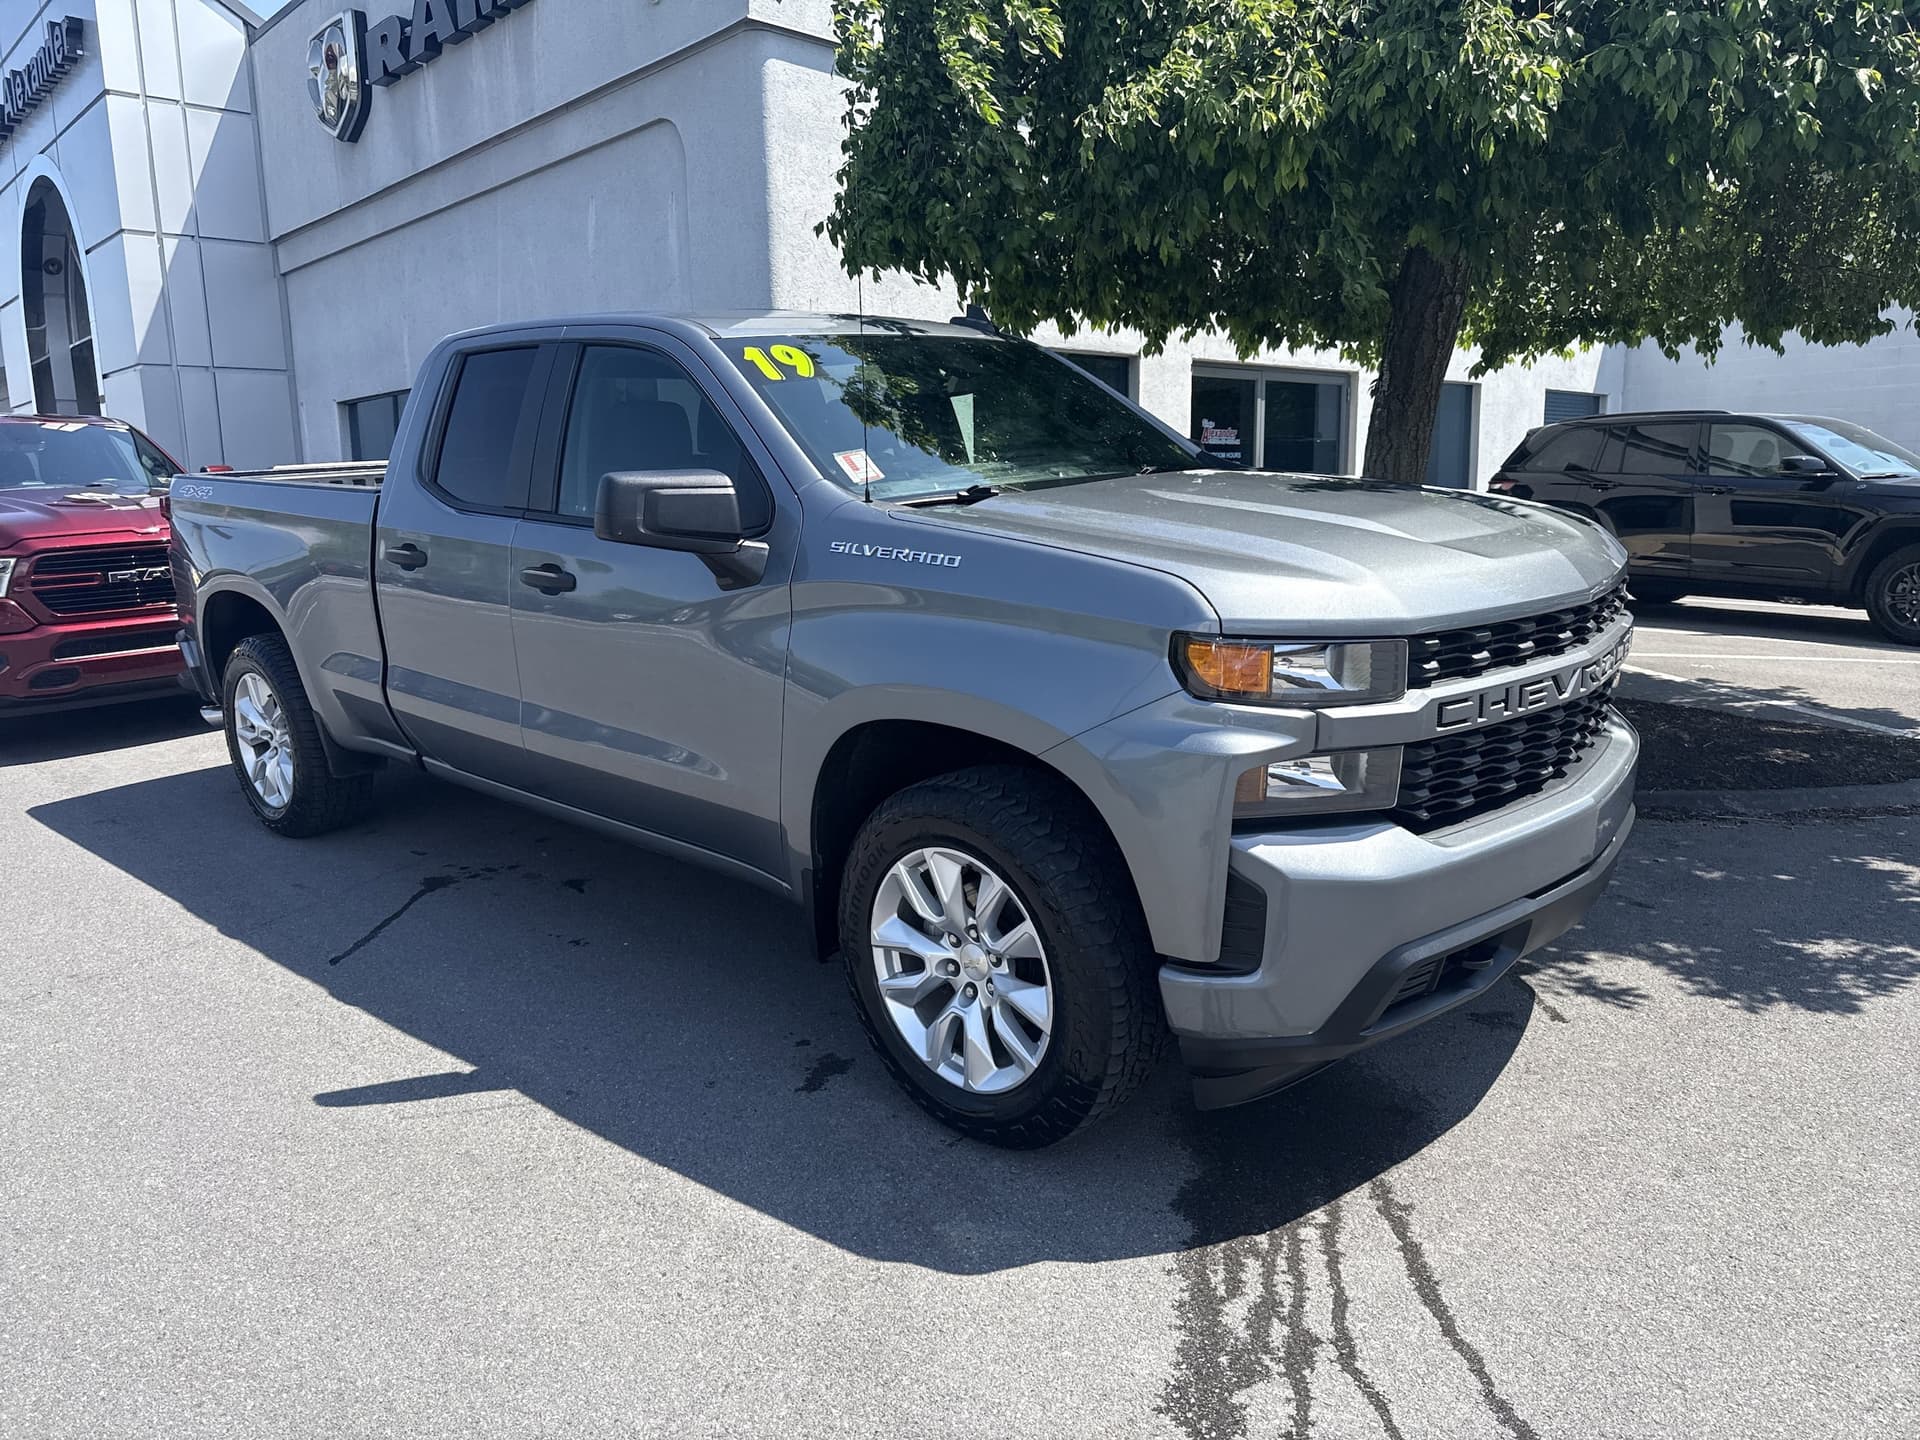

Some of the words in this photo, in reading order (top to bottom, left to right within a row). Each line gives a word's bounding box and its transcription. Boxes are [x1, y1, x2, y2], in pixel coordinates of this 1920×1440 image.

[3, 16, 80, 126] Alexander
[743, 344, 815, 381] 19
[829, 541, 962, 568] SILVERADO
[108, 566, 171, 583] RA
[1435, 628, 1633, 732] CHEVROLE
